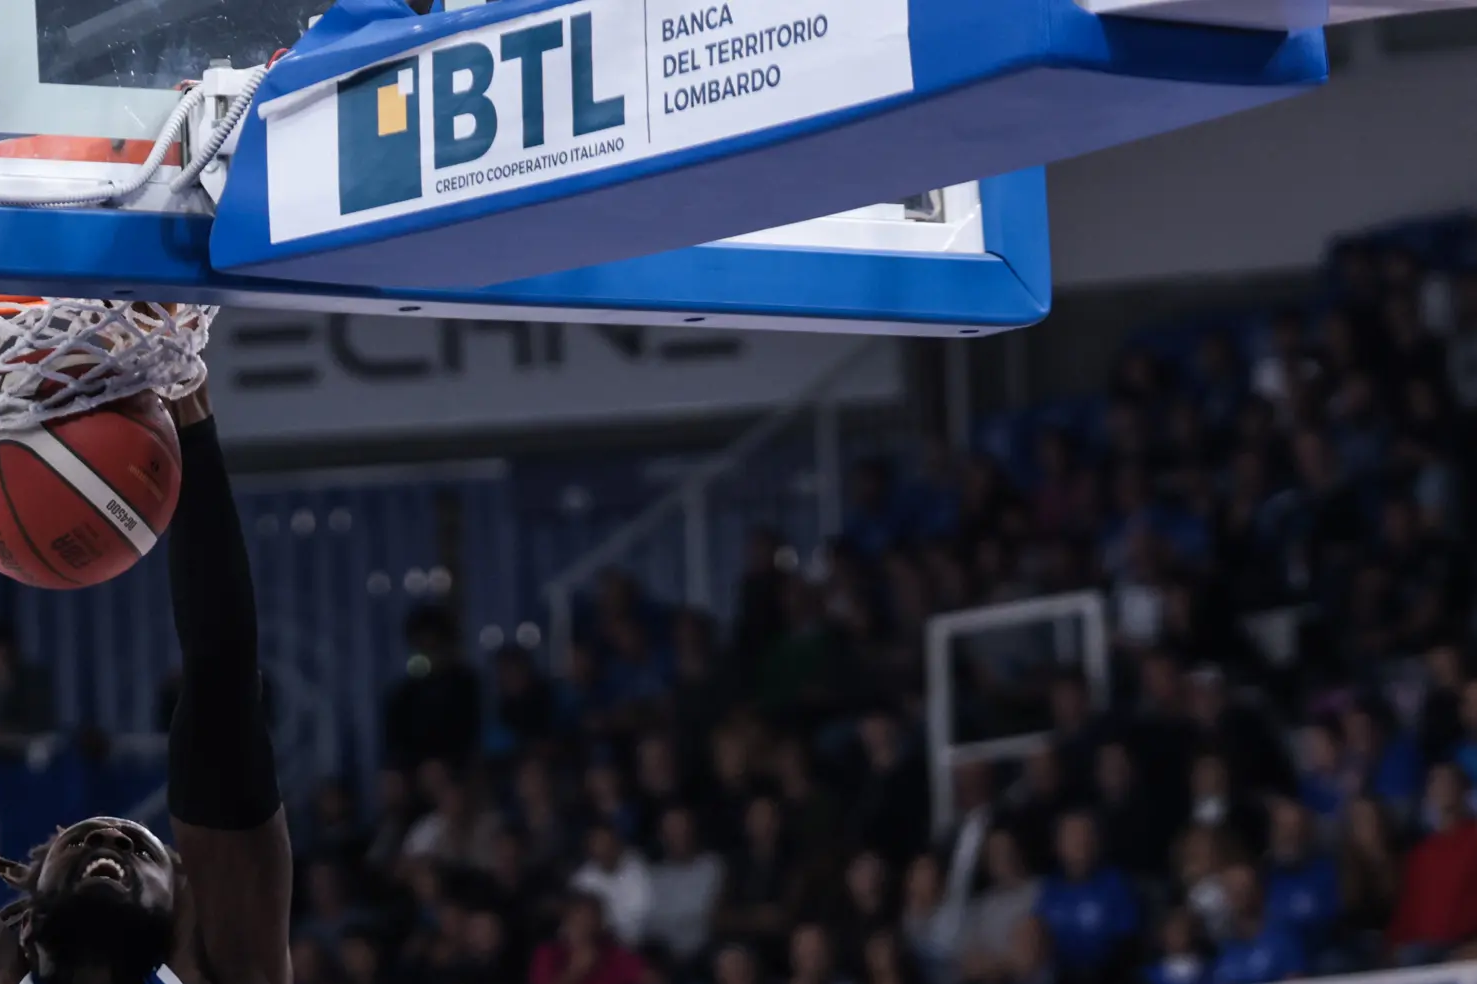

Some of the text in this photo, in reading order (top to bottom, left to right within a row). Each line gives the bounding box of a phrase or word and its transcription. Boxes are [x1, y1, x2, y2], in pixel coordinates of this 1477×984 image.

[662, 4, 733, 42] BANCA
[663, 14, 828, 78] DEL TERRITORIO
[432, 11, 625, 170] BTL
[664, 64, 781, 114] LOMBARDO
[435, 137, 625, 194] CREDITO COOPERATIVO ITALIANO
